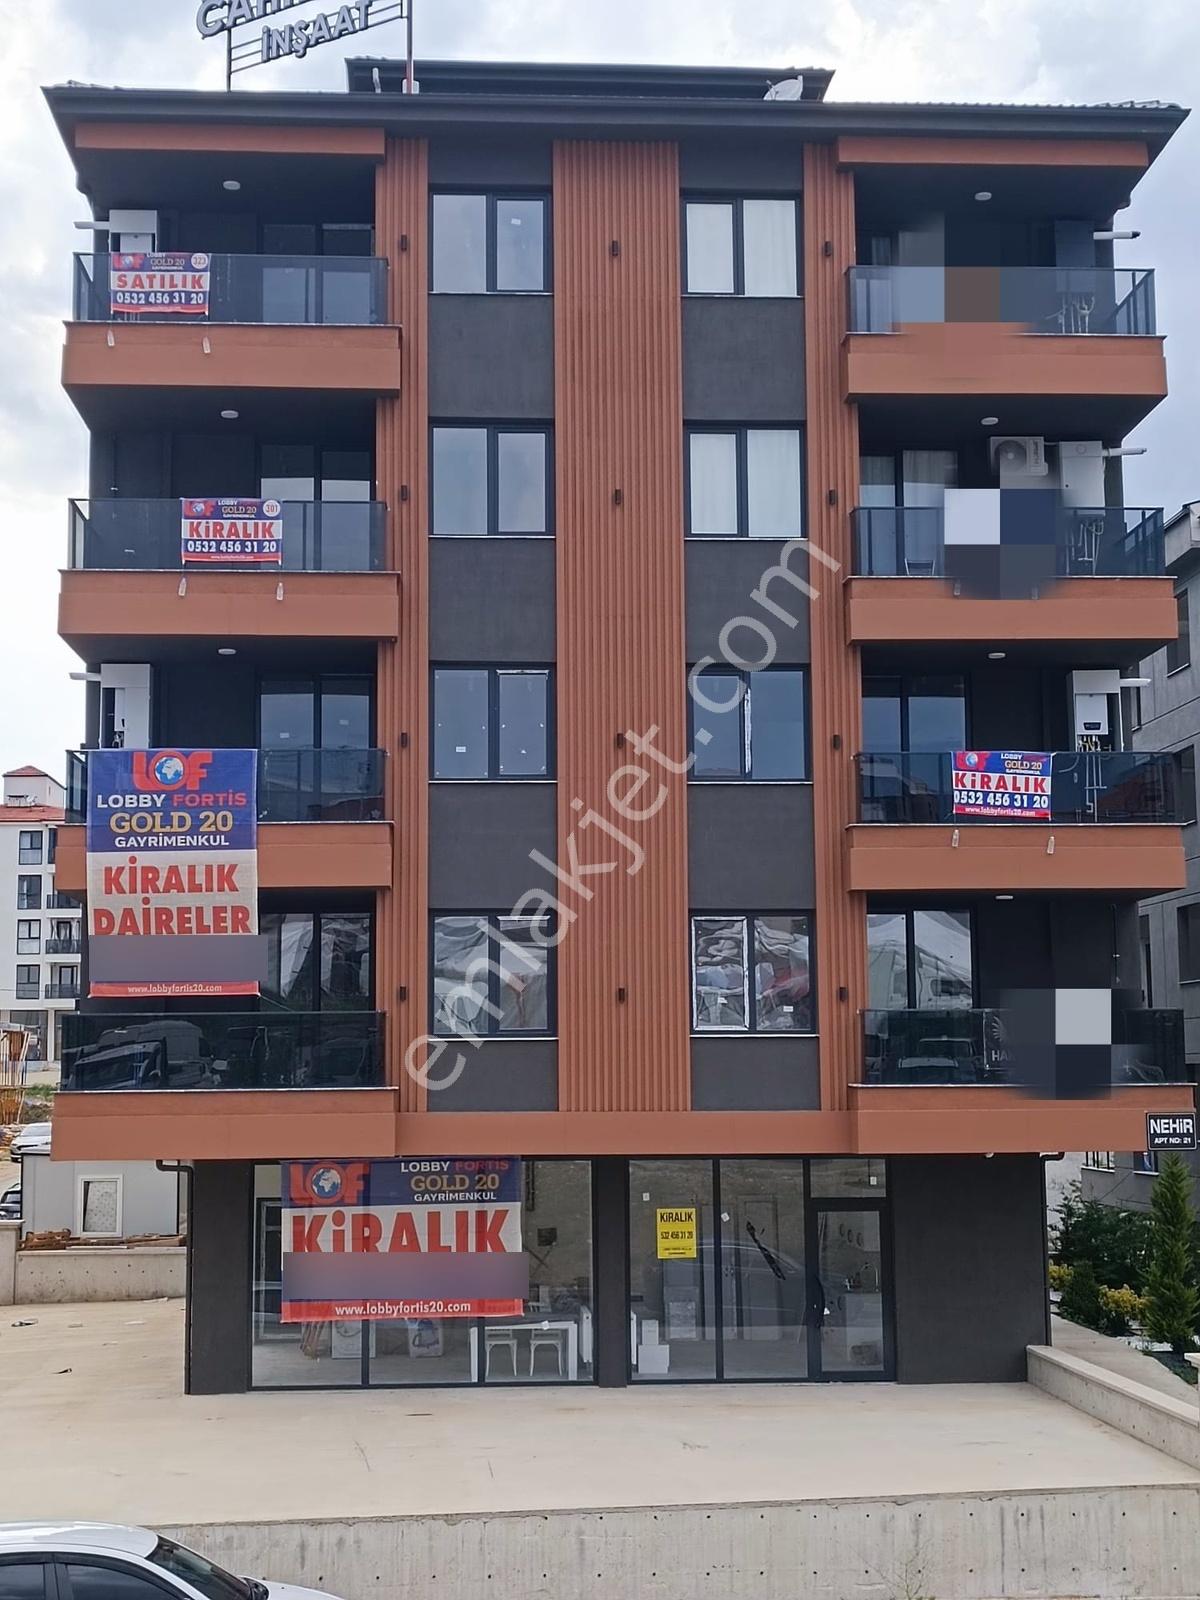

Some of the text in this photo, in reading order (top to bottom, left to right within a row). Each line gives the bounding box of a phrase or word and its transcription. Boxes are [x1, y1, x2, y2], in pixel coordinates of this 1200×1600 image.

[150, 258, 185, 266] GOLD 20
[116, 273, 204, 290] SATILIK
[116, 292, 204, 305] 0532 456 31 20
[222, 505, 257, 514] GOLD 20
[187, 540, 277, 553] 0532 456 31 20
[1004, 760, 1043, 771] GOLD 20
[97, 794, 167, 809] LOBBY
[953, 790, 1049, 809] 0532 456 31 20
[109, 810, 233, 834] GOLD 20
[114, 832, 230, 848] GAYRİMENKUL
[127, 982, 223, 995] www.lobbyfortis20.com
[400, 1160, 450, 1173] LOBBY
[410, 1173, 500, 1192] GOLD 20
[414, 1190, 497, 1203] GAYRİMENKUL
[335, 1300, 471, 1318] www.lobbyfortis20.com
